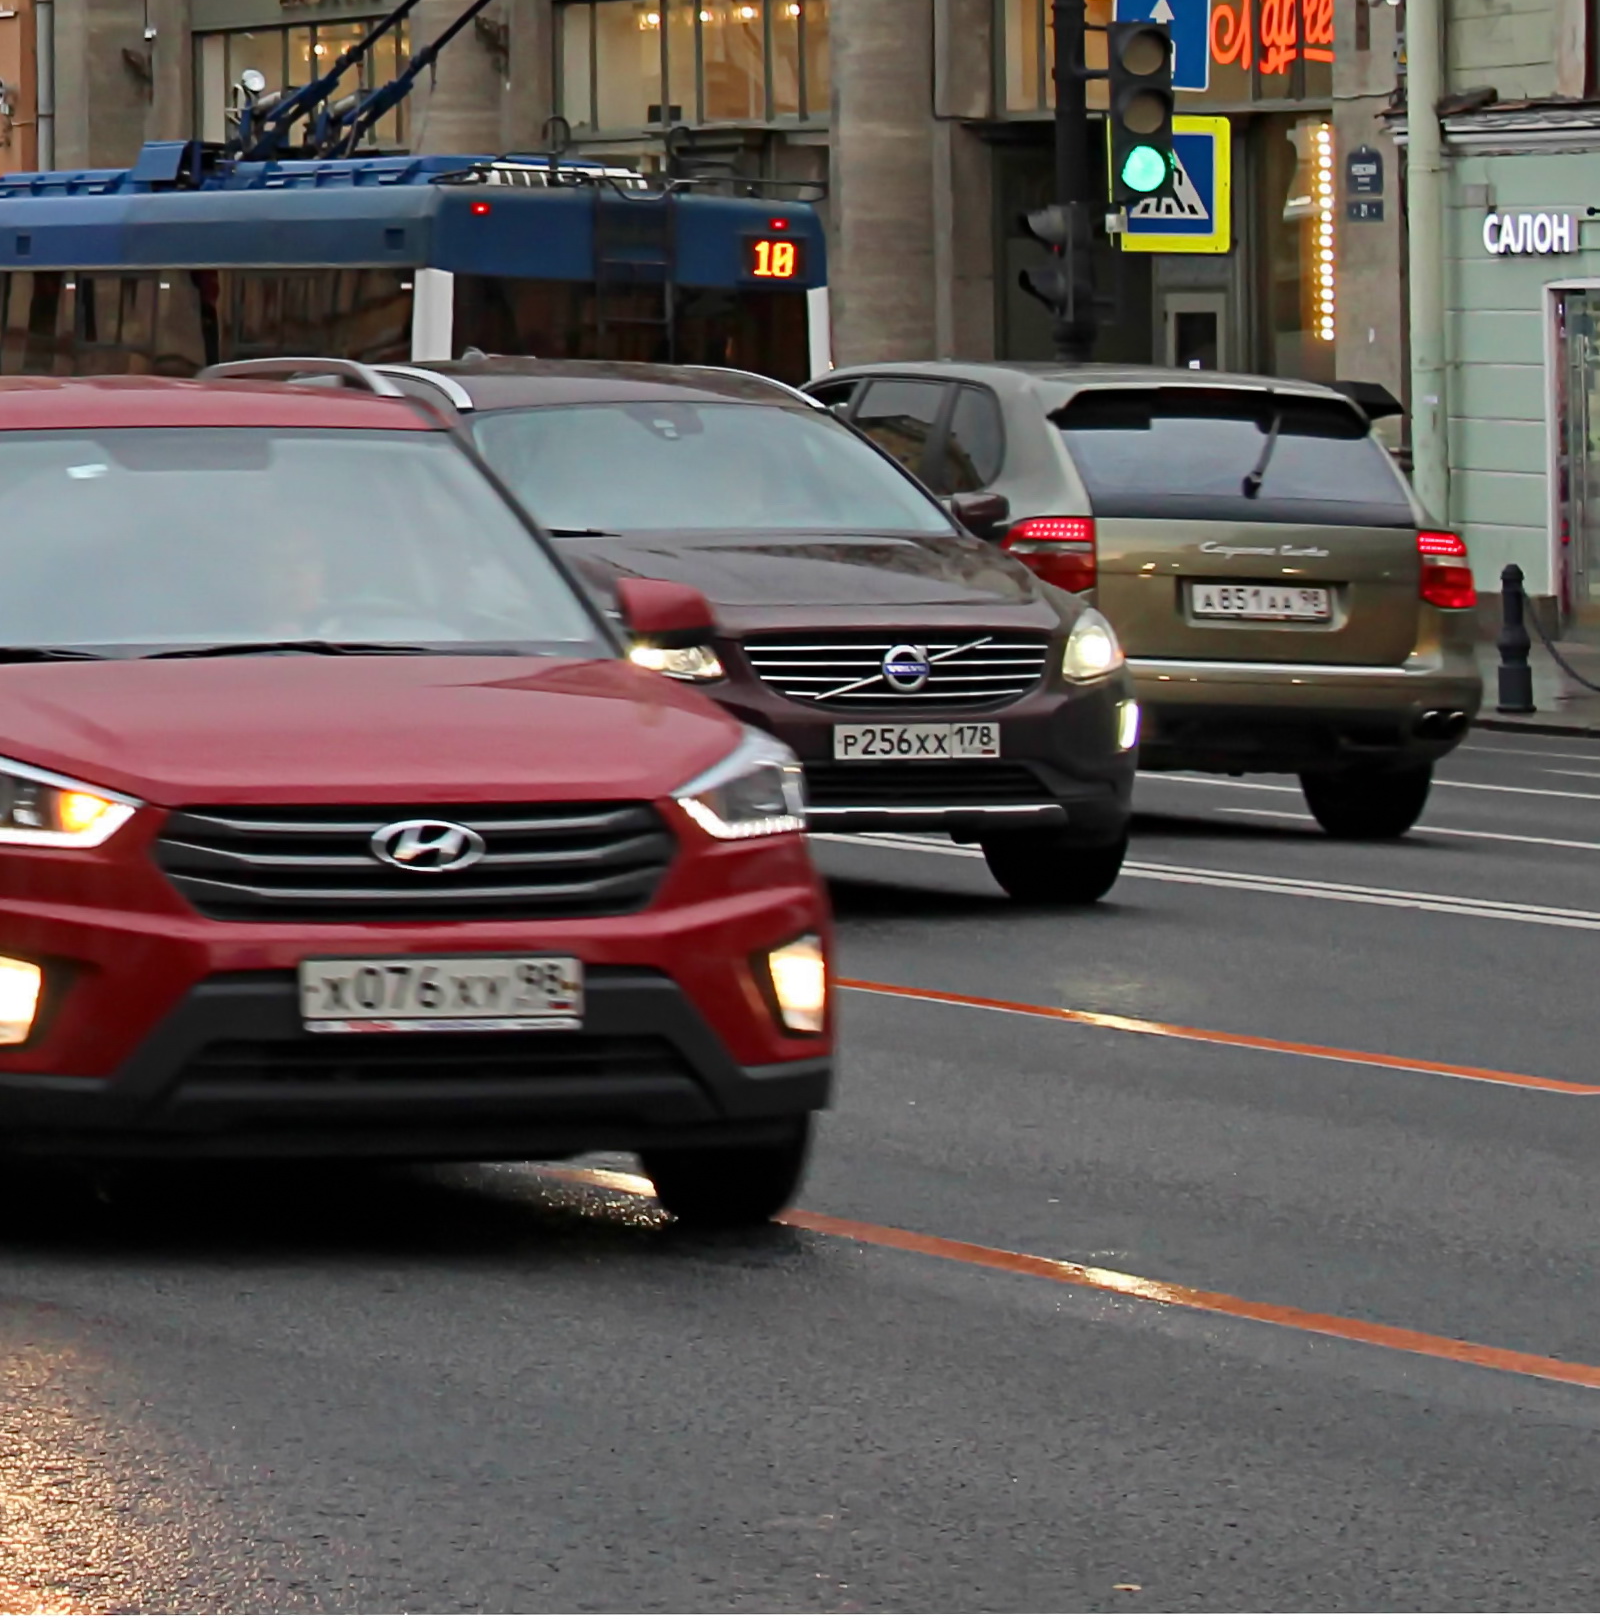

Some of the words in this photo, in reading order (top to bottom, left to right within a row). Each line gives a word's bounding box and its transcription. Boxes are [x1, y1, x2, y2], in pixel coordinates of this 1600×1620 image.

[1483, 212, 1570, 254] САЛОН
[754, 241, 794, 277] 10
[1203, 587, 1292, 611] А851АА
[843, 728, 948, 755] Р256ХХ
[954, 725, 993, 746] 178
[320, 965, 510, 1010] Х076ХУ
